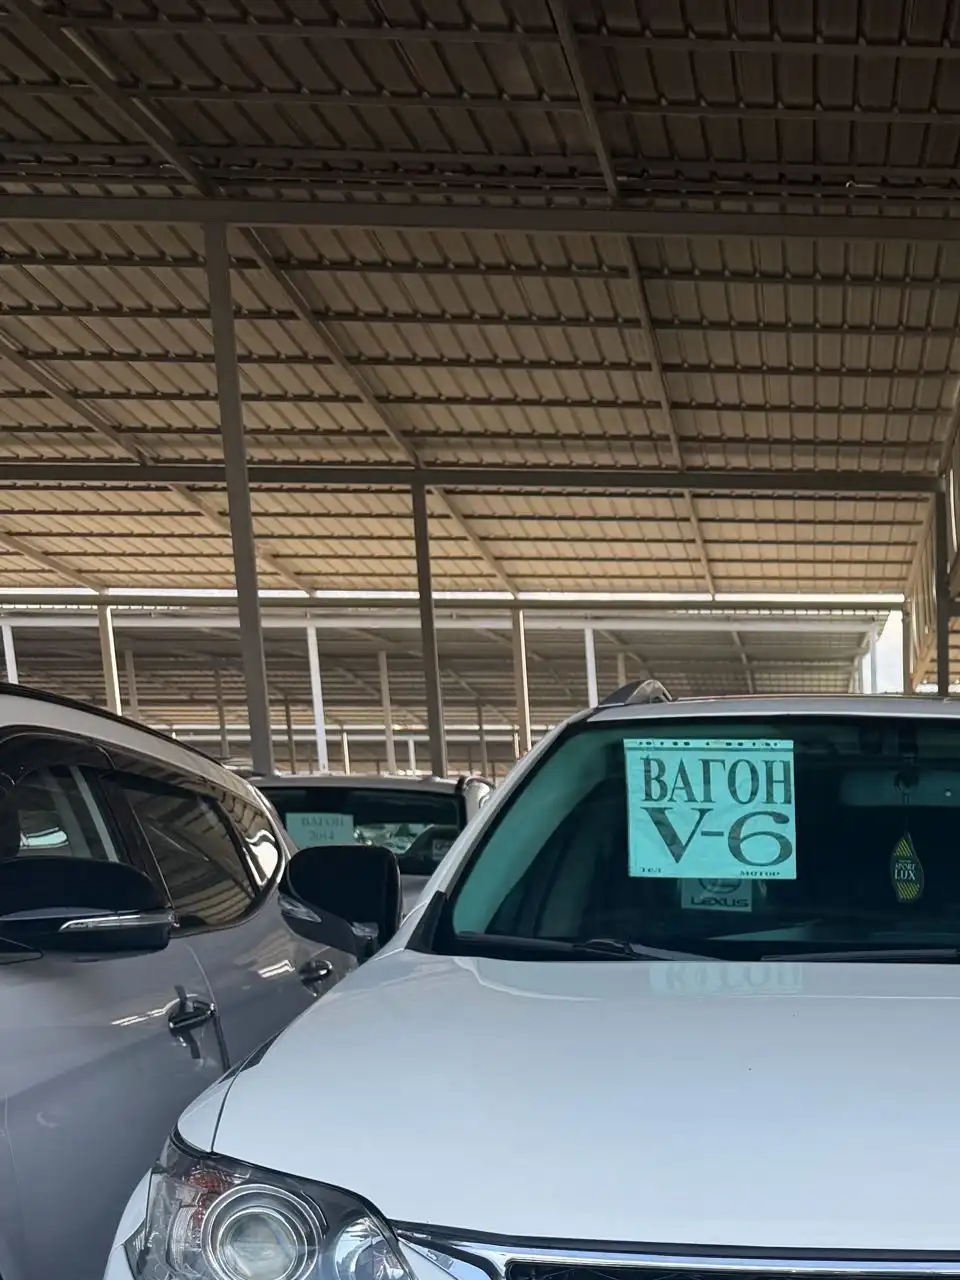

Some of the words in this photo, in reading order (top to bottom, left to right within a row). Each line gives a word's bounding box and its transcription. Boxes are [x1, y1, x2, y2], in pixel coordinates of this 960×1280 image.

[640, 757, 793, 805] ВАГОН
[640, 807, 793, 867] V-6
[690, 896, 749, 908] LEXUS
